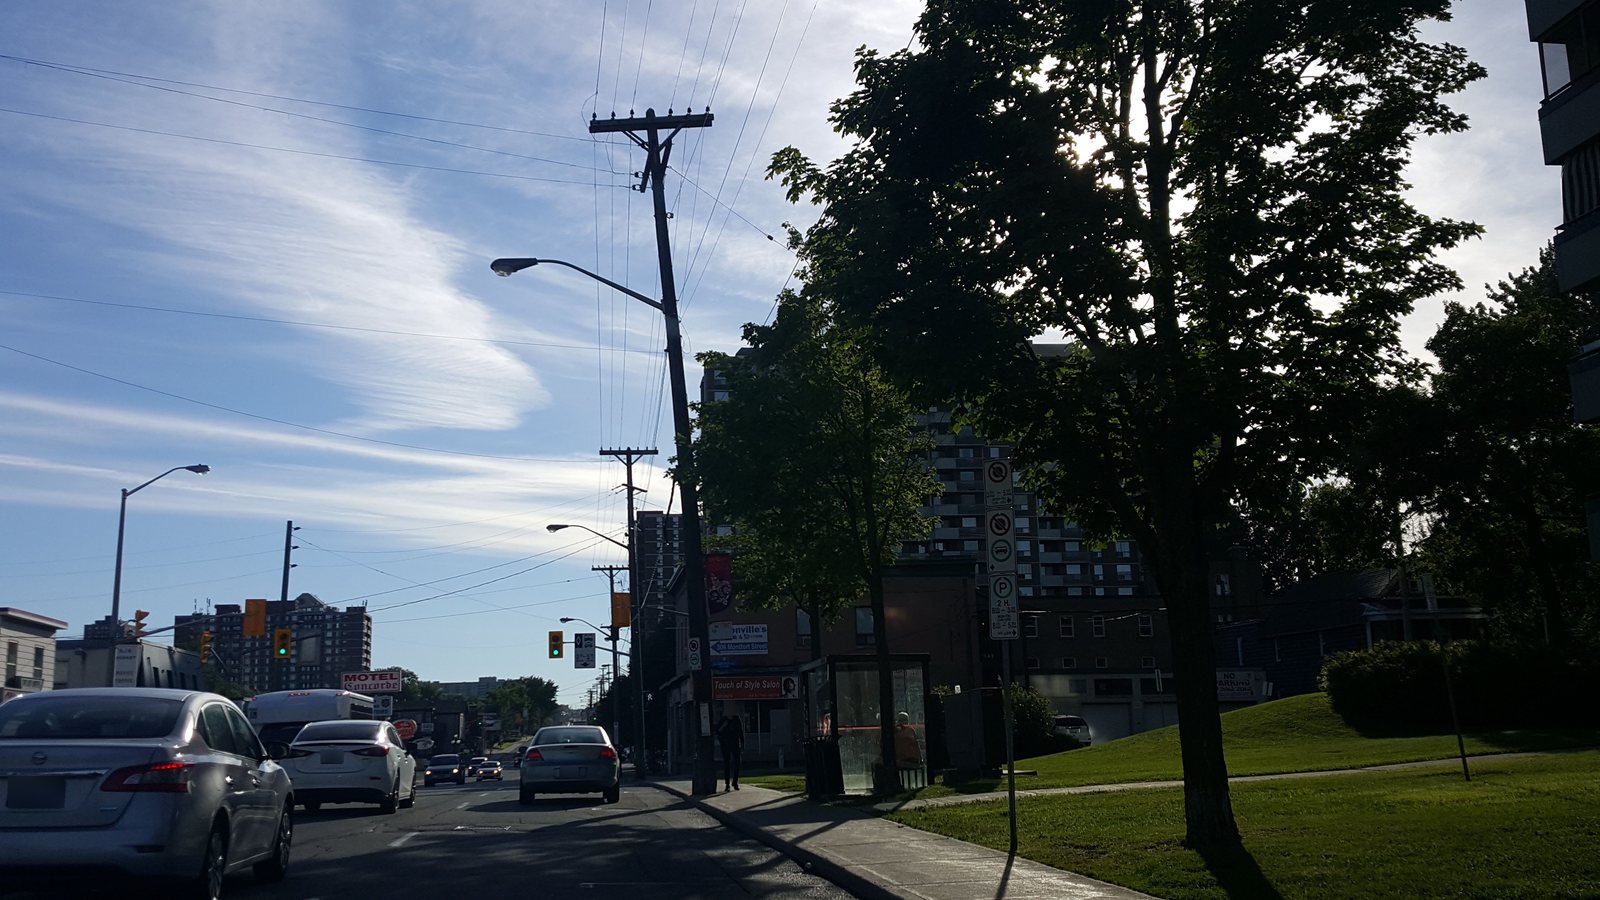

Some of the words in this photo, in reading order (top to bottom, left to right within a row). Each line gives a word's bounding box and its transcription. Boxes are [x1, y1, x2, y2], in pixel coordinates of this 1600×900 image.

[1000, 582, 1007, 593] P
[344, 673, 398, 682] MOTEL
[344, 682, 398, 691] Concorde
[715, 681, 735, 689] Touch
[736, 681, 744, 689] of
[745, 681, 760, 691] Style
[762, 680, 780, 689] Salon
